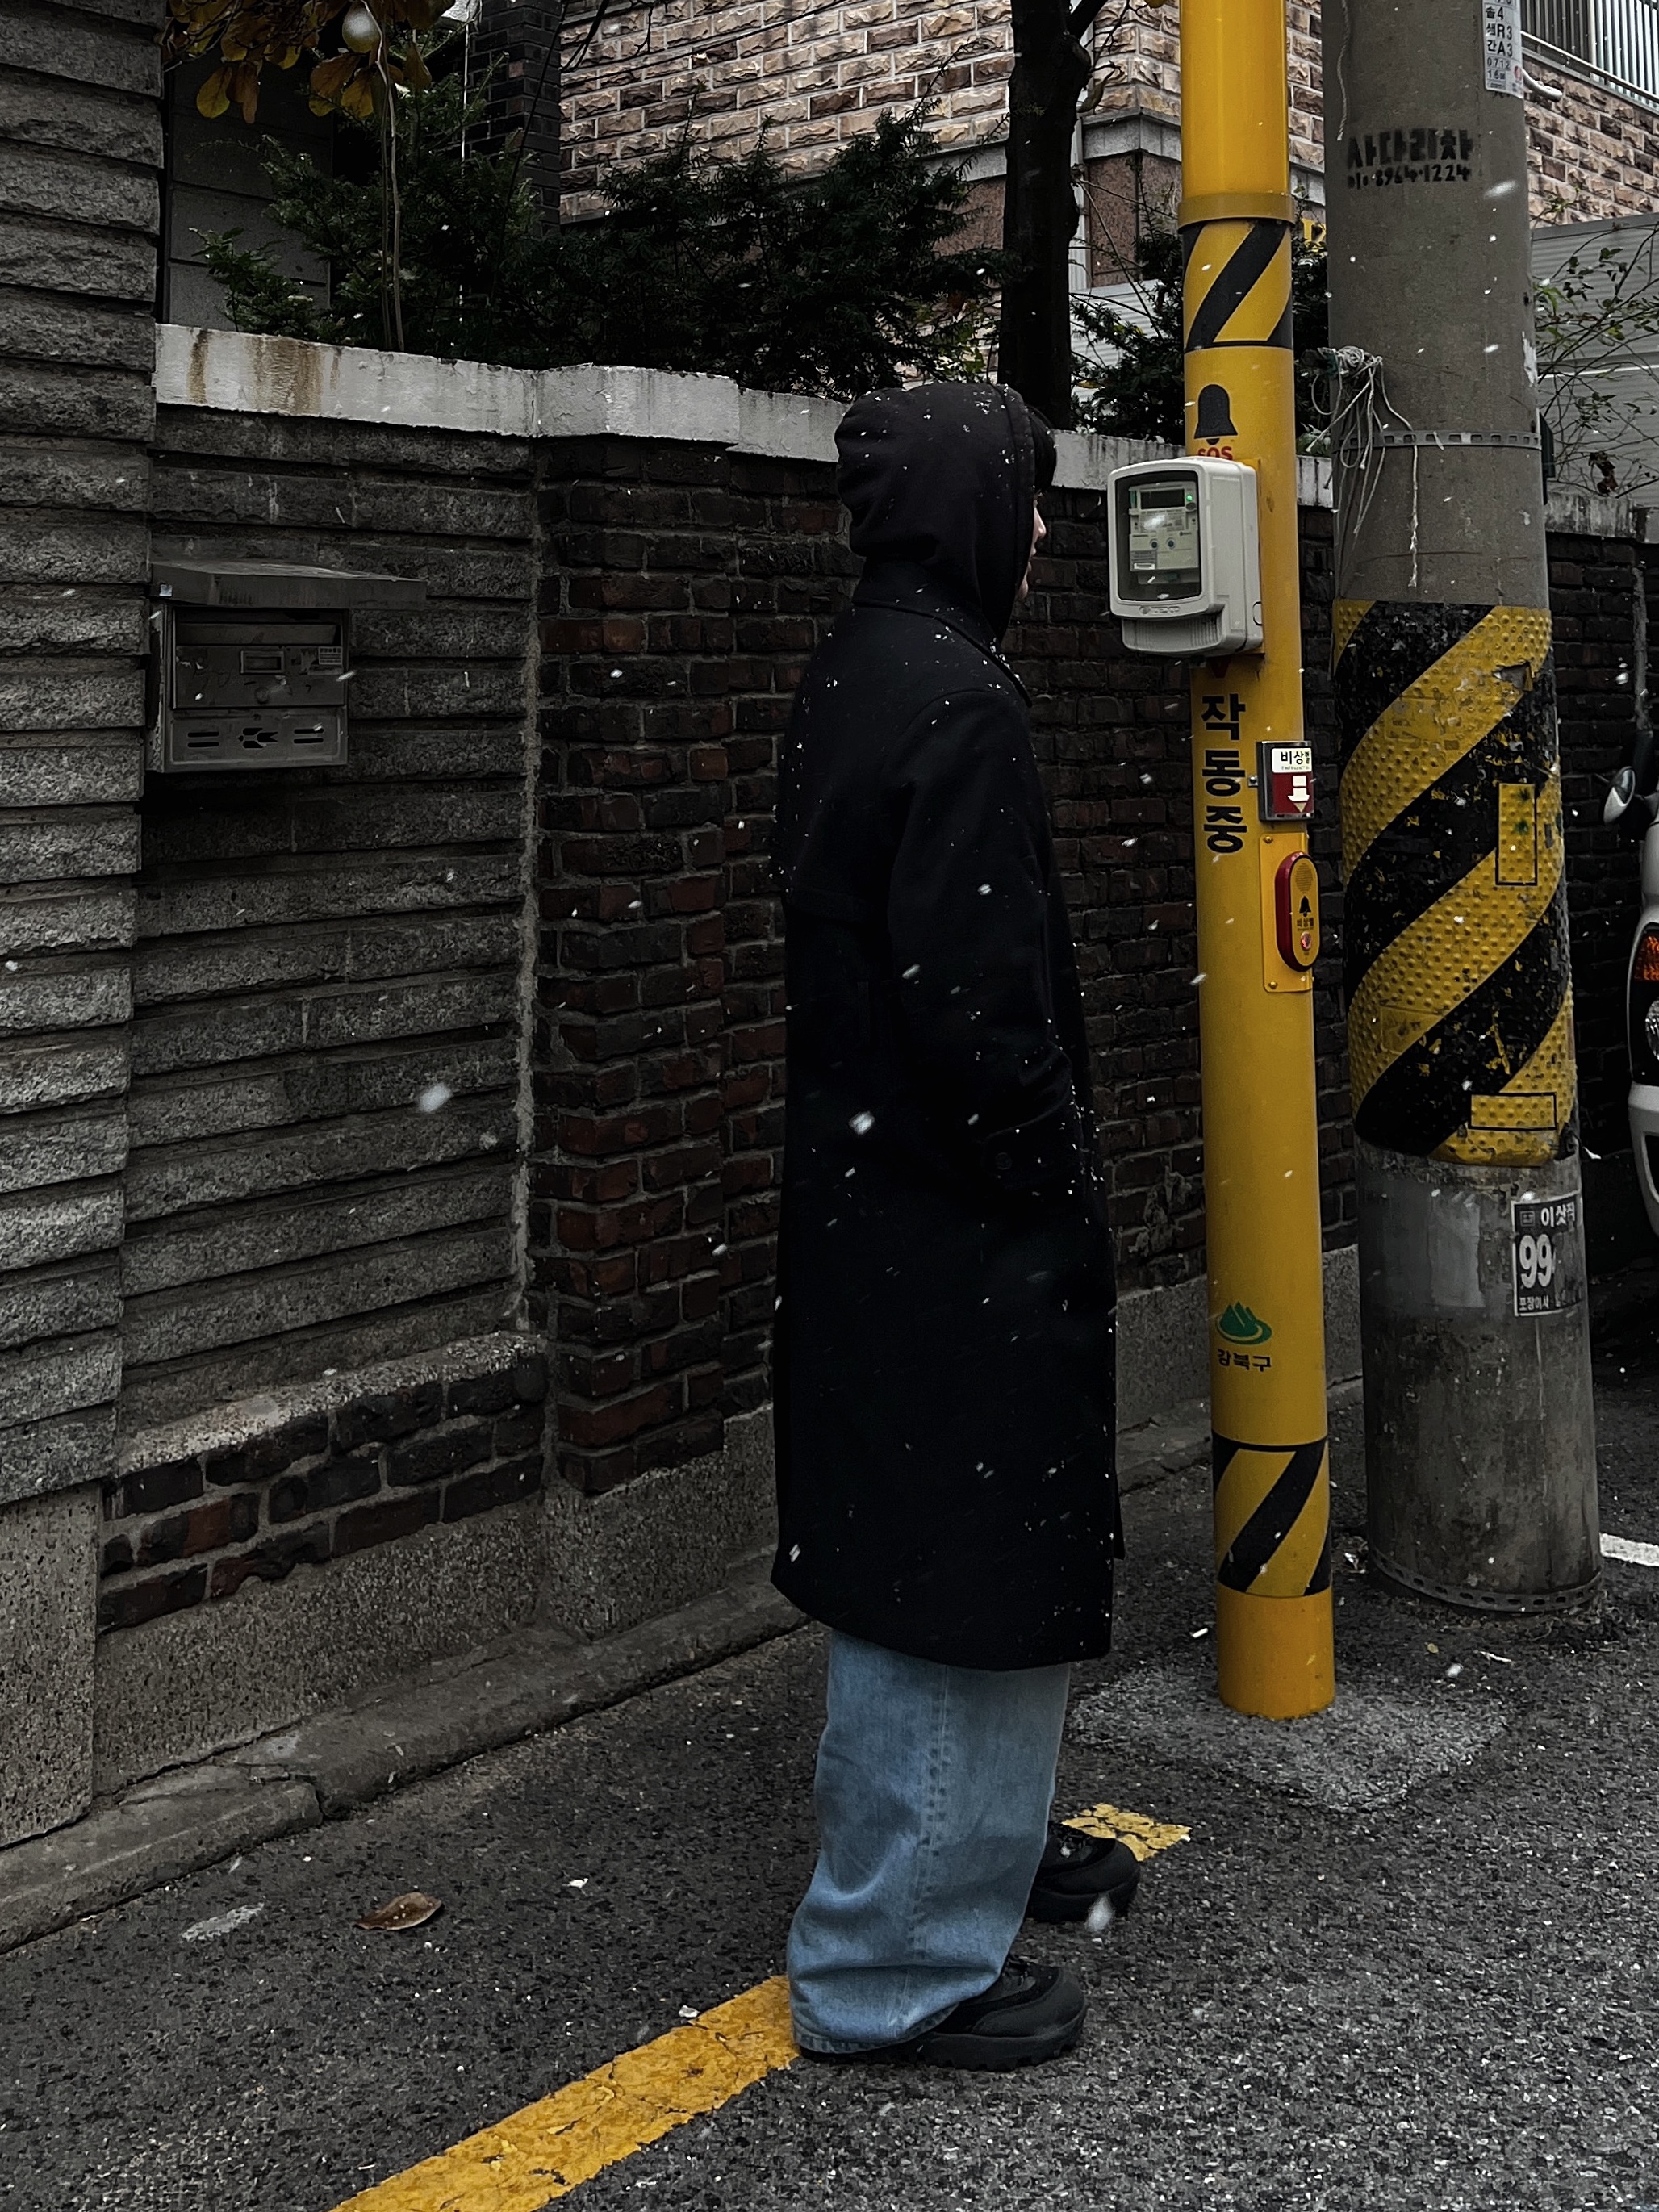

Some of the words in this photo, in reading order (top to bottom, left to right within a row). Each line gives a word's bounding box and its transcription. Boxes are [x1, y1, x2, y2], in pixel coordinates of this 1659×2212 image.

[1487, 57, 1511, 71] 0712
[1348, 128, 1473, 169] 사다리차
[1201, 692, 1247, 854] 작동중
[1519, 1295, 1549, 1311] 포장이사
[1217, 1349, 1272, 1372] 강북구
